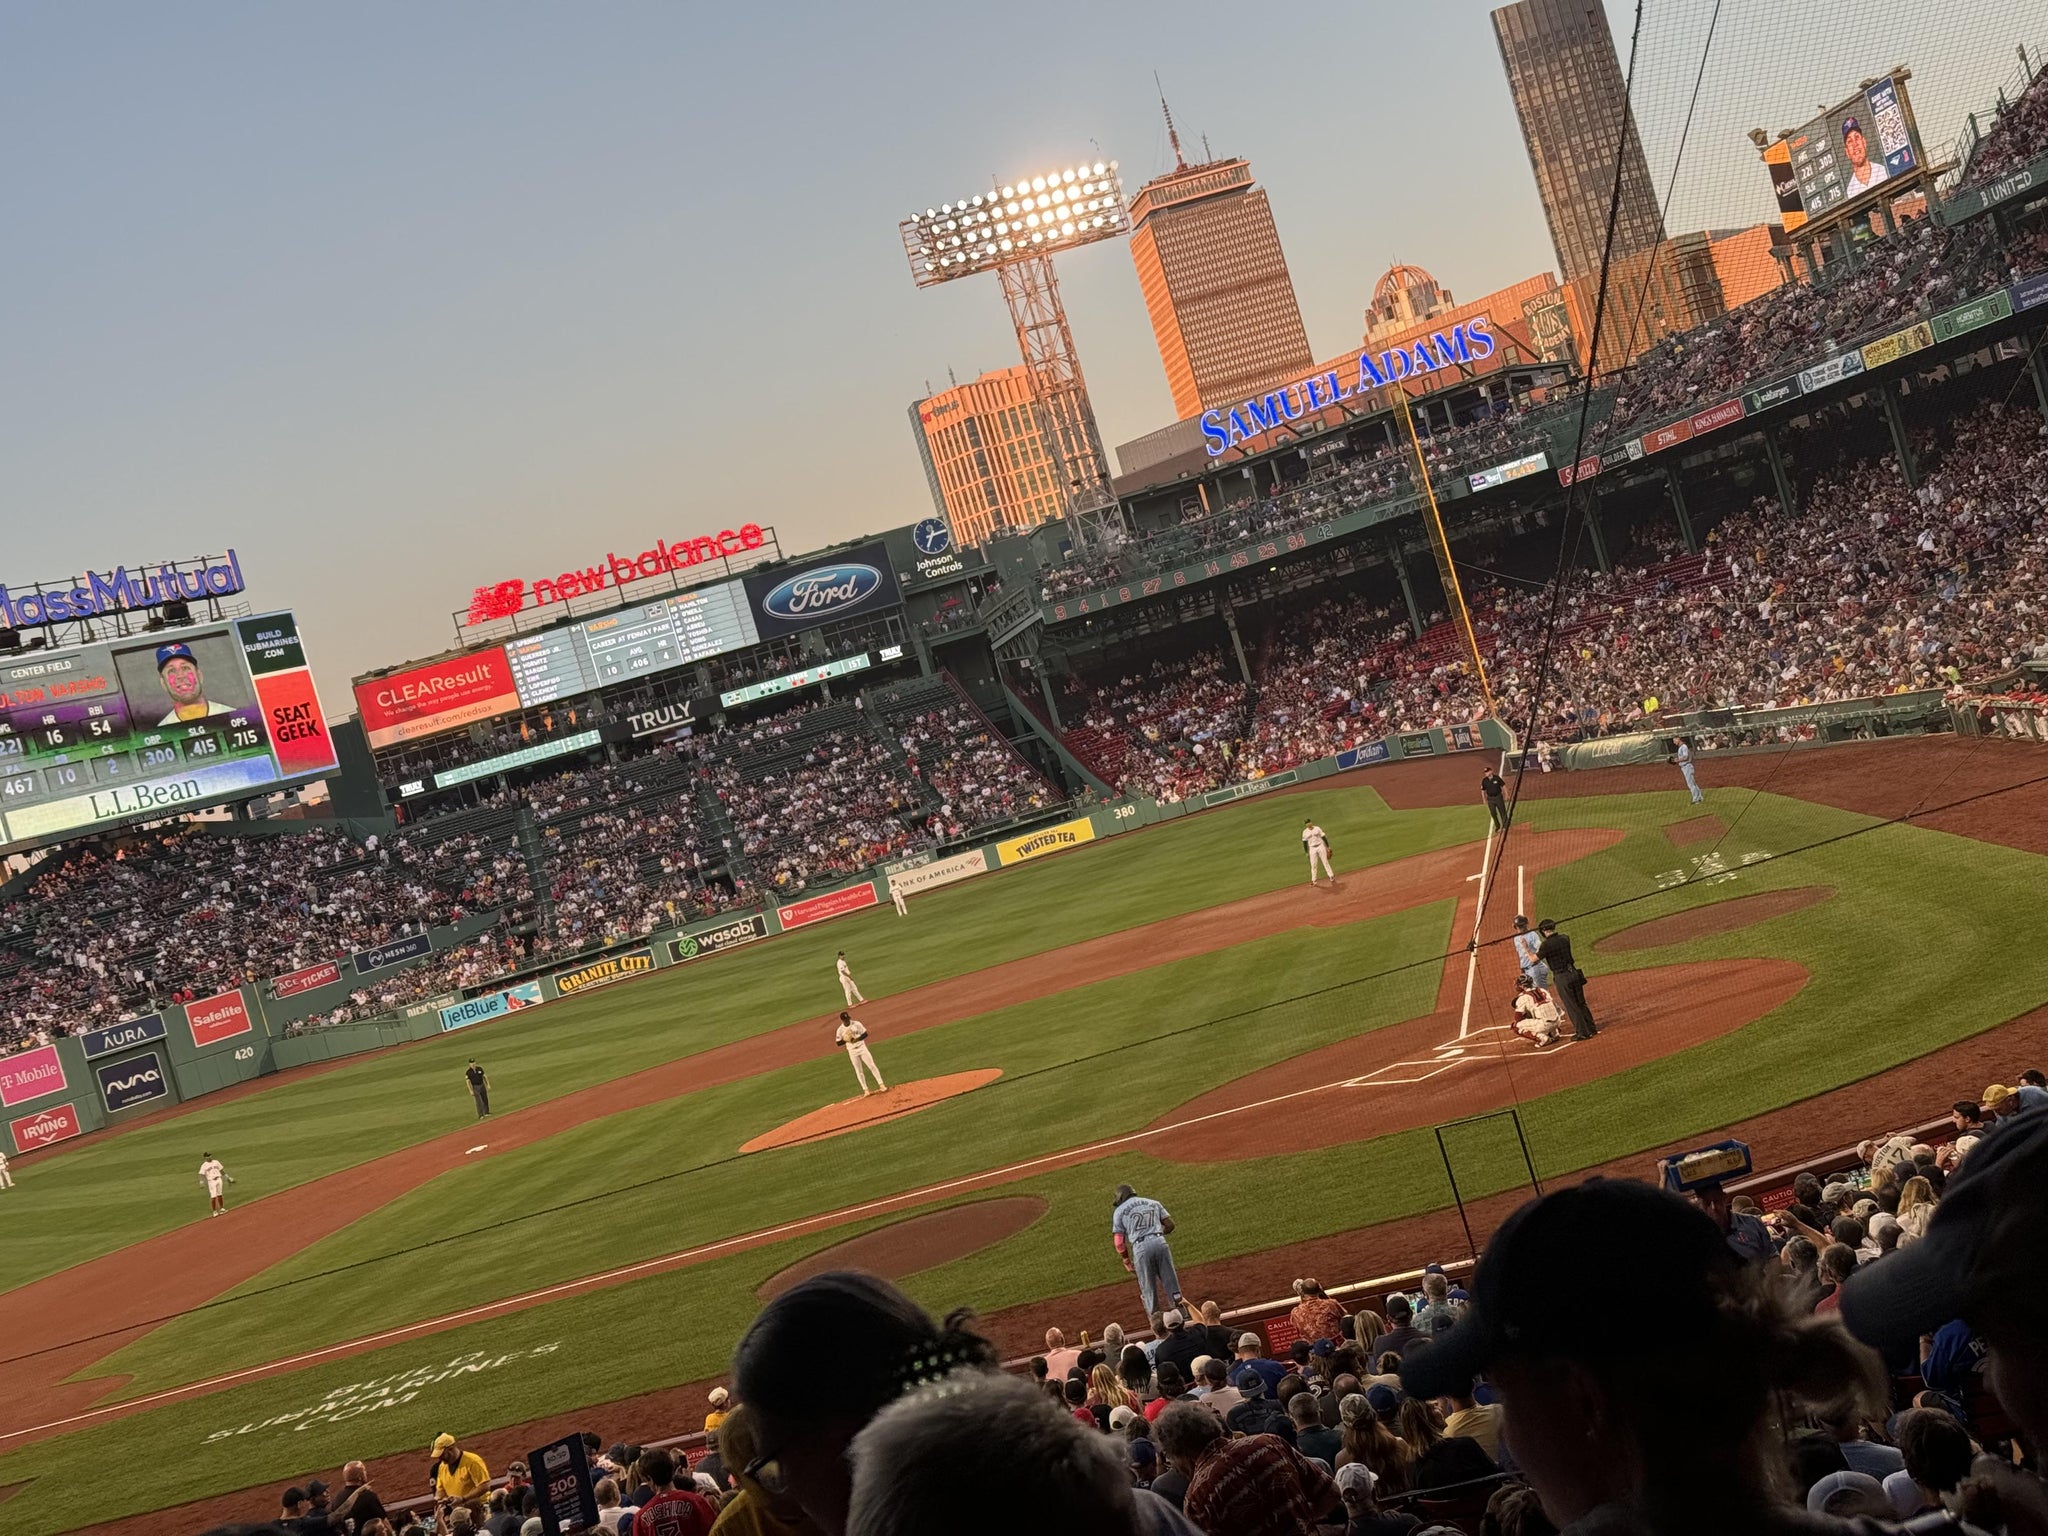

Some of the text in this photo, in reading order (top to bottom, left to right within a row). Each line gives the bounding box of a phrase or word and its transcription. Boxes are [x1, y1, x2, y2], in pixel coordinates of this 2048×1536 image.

[1523, 292, 1561, 316] BOSTON
[1200, 317, 1495, 457] SAMUEL ADAMS
[1657, 430, 1678, 446] STIHL
[1312, 441, 1345, 458] SAM DECK
[532, 522, 764, 607] new balance
[916, 554, 953, 572] Johnson
[925, 561, 963, 578] Controls
[1055, 605, 1066, 620] 9
[1079, 599, 1089, 612] 4
[1101, 594, 1109, 608] 1
[1142, 577, 1162, 595] 27
[1204, 561, 1219, 576] 14
[1230, 552, 1248, 568] 45
[1286, 533, 1306, 550] 34
[1317, 524, 1333, 539] 42
[0, 549, 245, 627] assMutual
[790, 573, 858, 613] Ford
[683, 614, 703, 624] CASAS
[245, 636, 299, 653] SUBMARINES
[256, 630, 282, 641] BUILD
[592, 623, 670, 650] CAREER AT FENWAY PARK
[691, 639, 724, 653] GONZALEZ
[264, 649, 285, 658] .COM
[520, 648, 551, 661] GUERRERO
[629, 646, 643, 656] AVG
[657, 639, 668, 648] HR
[11, 661, 72, 678] CENTER FIELD
[607, 666, 618, 676] 10
[630, 657, 649, 670] .406
[49, 675, 107, 699] VARSHO
[377, 664, 491, 707] CLEAResult
[531, 684, 558, 696] CLEMENT
[273, 702, 311, 725] SEAT
[396, 704, 416, 715] change
[440, 692, 459, 703] people
[42, 705, 104, 725] HR RBI
[398, 704, 493, 736] clearesult.com/redsox
[627, 700, 692, 731] TRULY
[46, 730, 64, 745] 16
[90, 720, 112, 736] 54
[276, 720, 321, 743] GEEK
[5, 718, 248, 774] PA CS OBP SLG OPS
[5, 730, 258, 795] 467 10 2 .300 .415 .715
[399, 780, 423, 794] TRULY
[89, 779, 202, 821] L.L.Bean
[1113, 805, 1136, 820] 380
[1016, 834, 1056, 857] TWISTED
[1057, 832, 1076, 843] TEA
[884, 860, 913, 875] DICK'S
[916, 864, 965, 884] OF AMERICA
[698, 917, 755, 948] wasabi
[724, 937, 738, 947] cloud
[384, 944, 417, 959] NESN 360
[278, 966, 337, 996] ACE TICKET
[559, 956, 651, 993] GRANITE CITY
[192, 1006, 242, 1027] Safelite
[447, 1000, 498, 1028] jetBlue
[235, 1047, 254, 1061] 420
[15, 1063, 58, 1086] Mobile
[22, 1117, 68, 1140] IRVING
[1762, 1189, 1794, 1204] CAUTIO
[1130, 1210, 1155, 1232] 27
[1267, 1320, 1290, 1330] CAUTI
[549, 1475, 576, 1496] 300
[641, 1500, 693, 1526] YOSHIDA
